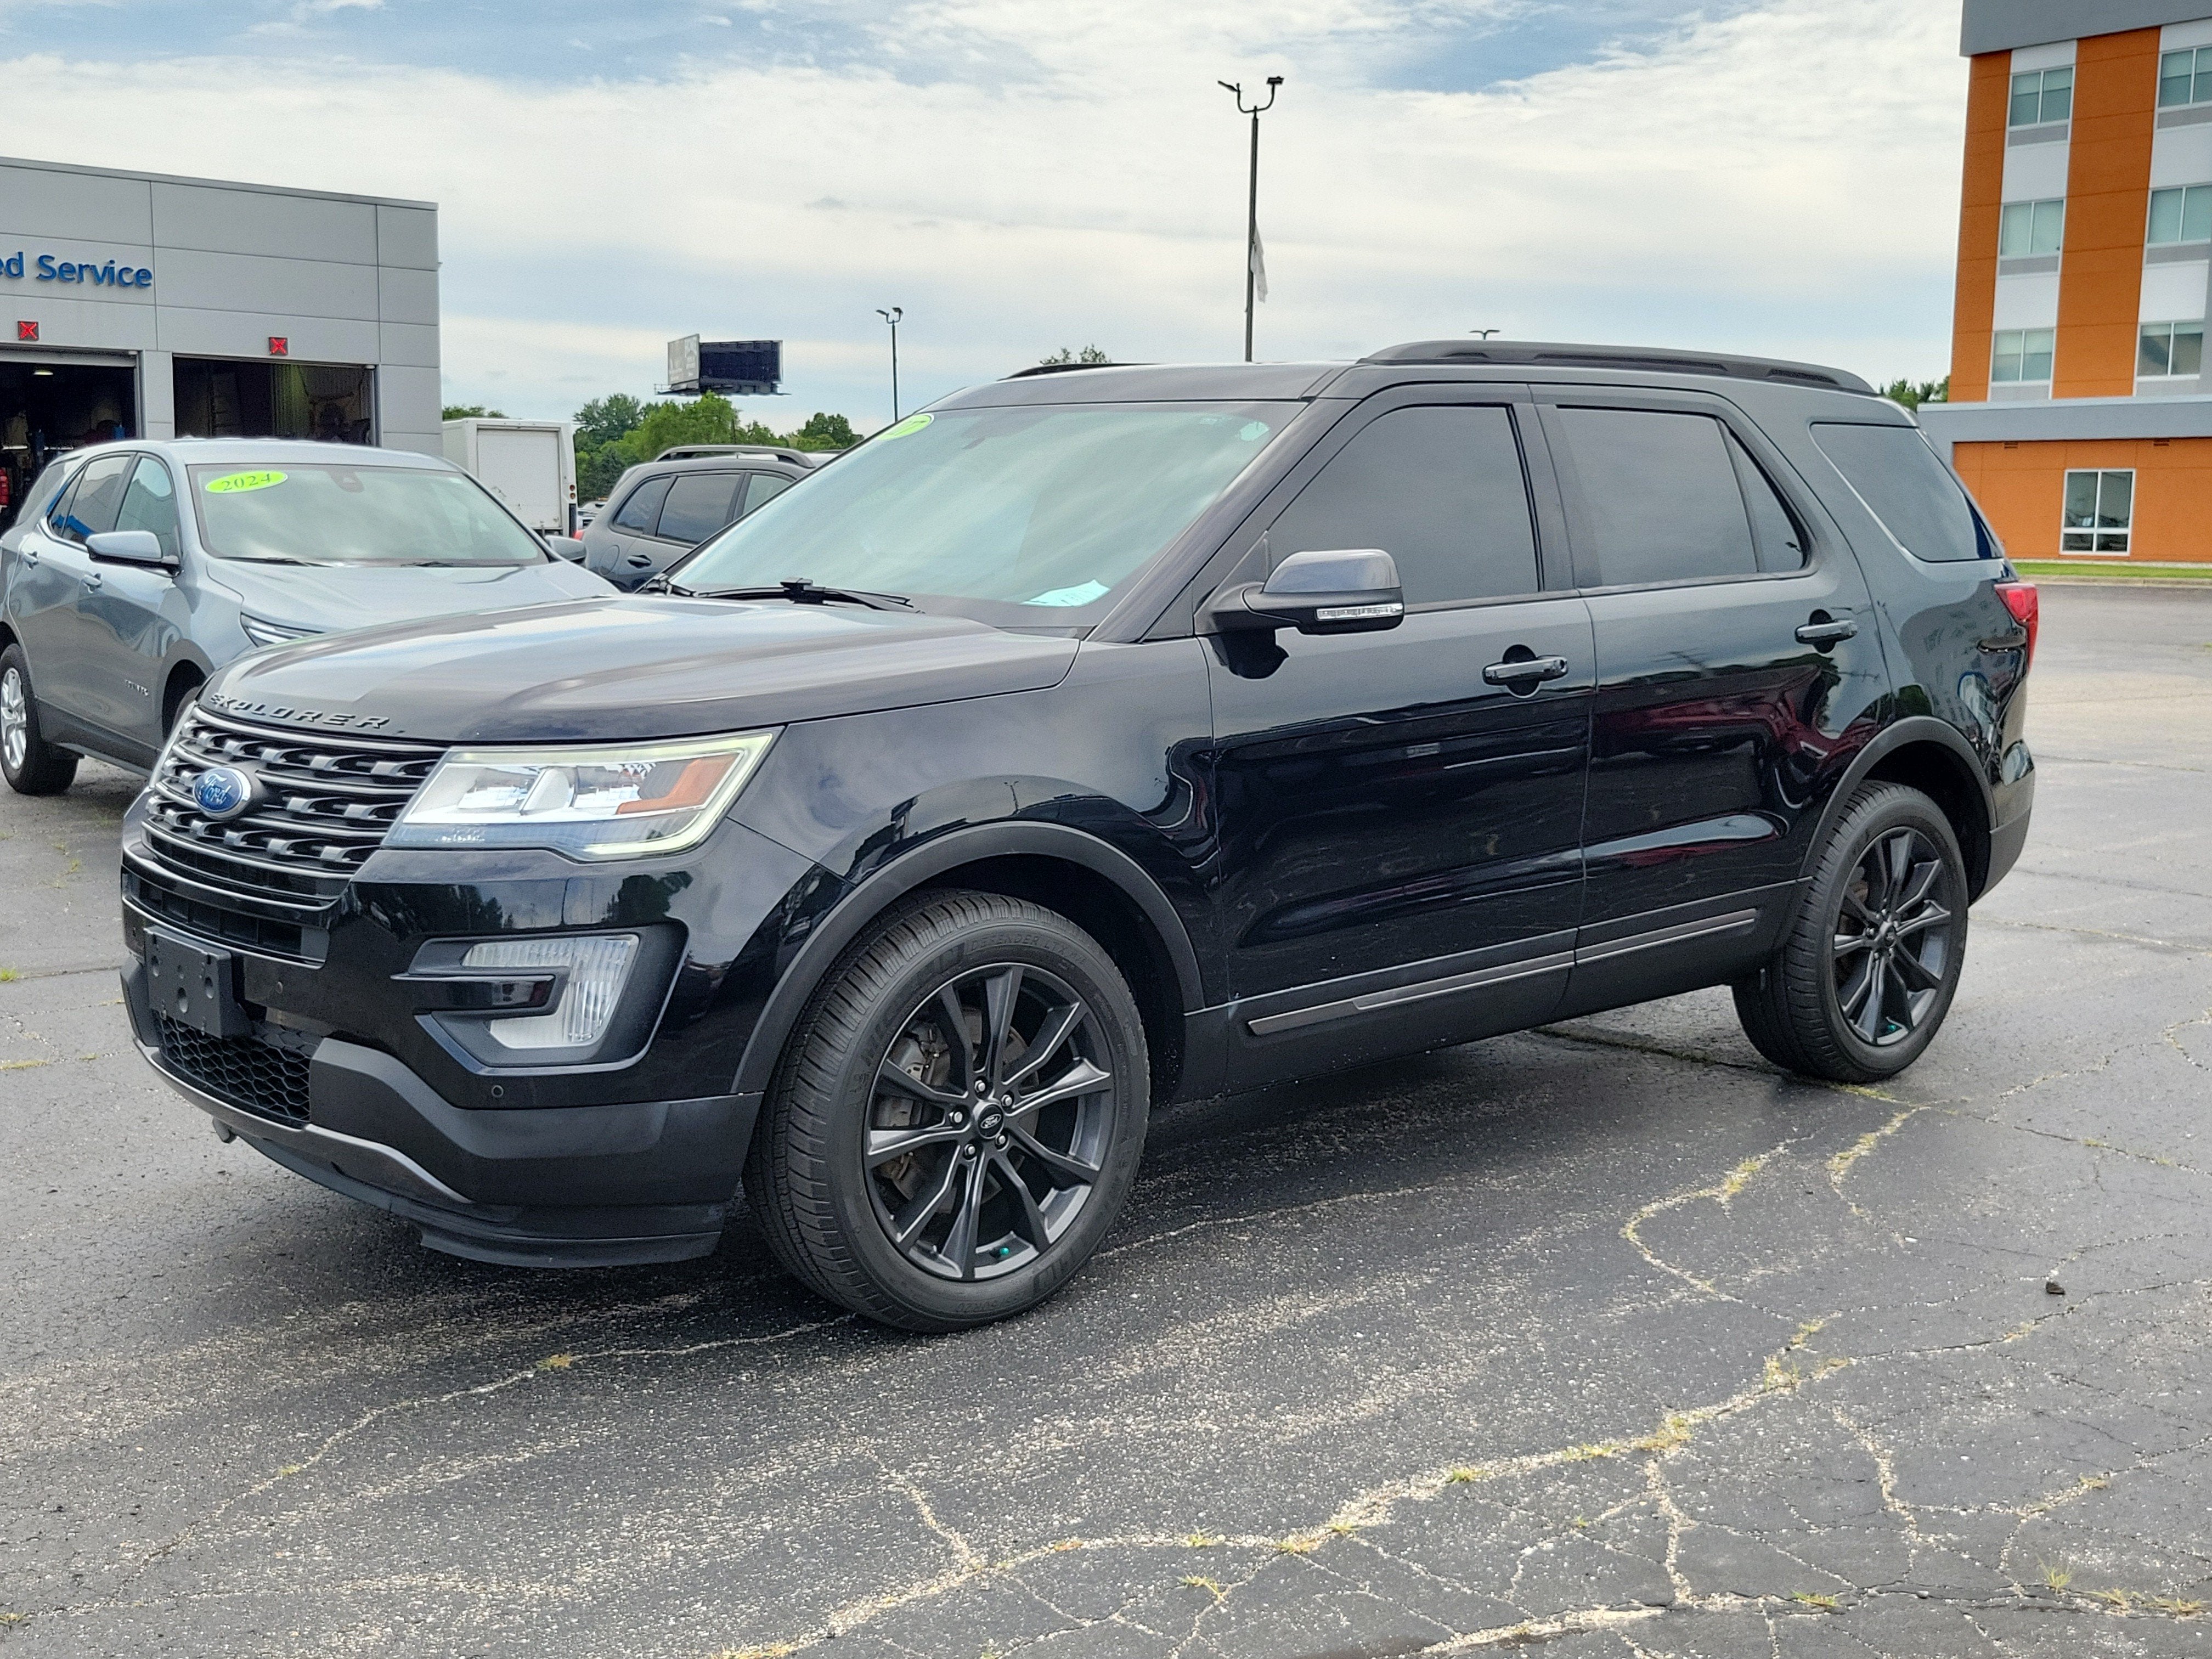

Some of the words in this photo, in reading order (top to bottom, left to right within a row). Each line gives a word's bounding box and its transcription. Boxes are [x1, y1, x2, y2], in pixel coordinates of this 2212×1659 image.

[36, 255, 153, 288] Service
[221, 473, 271, 492] 2024
[210, 692, 391, 730] EXPLORER
[198, 773, 232, 805] Ford
[970, 933, 1040, 951] DEFENDER
